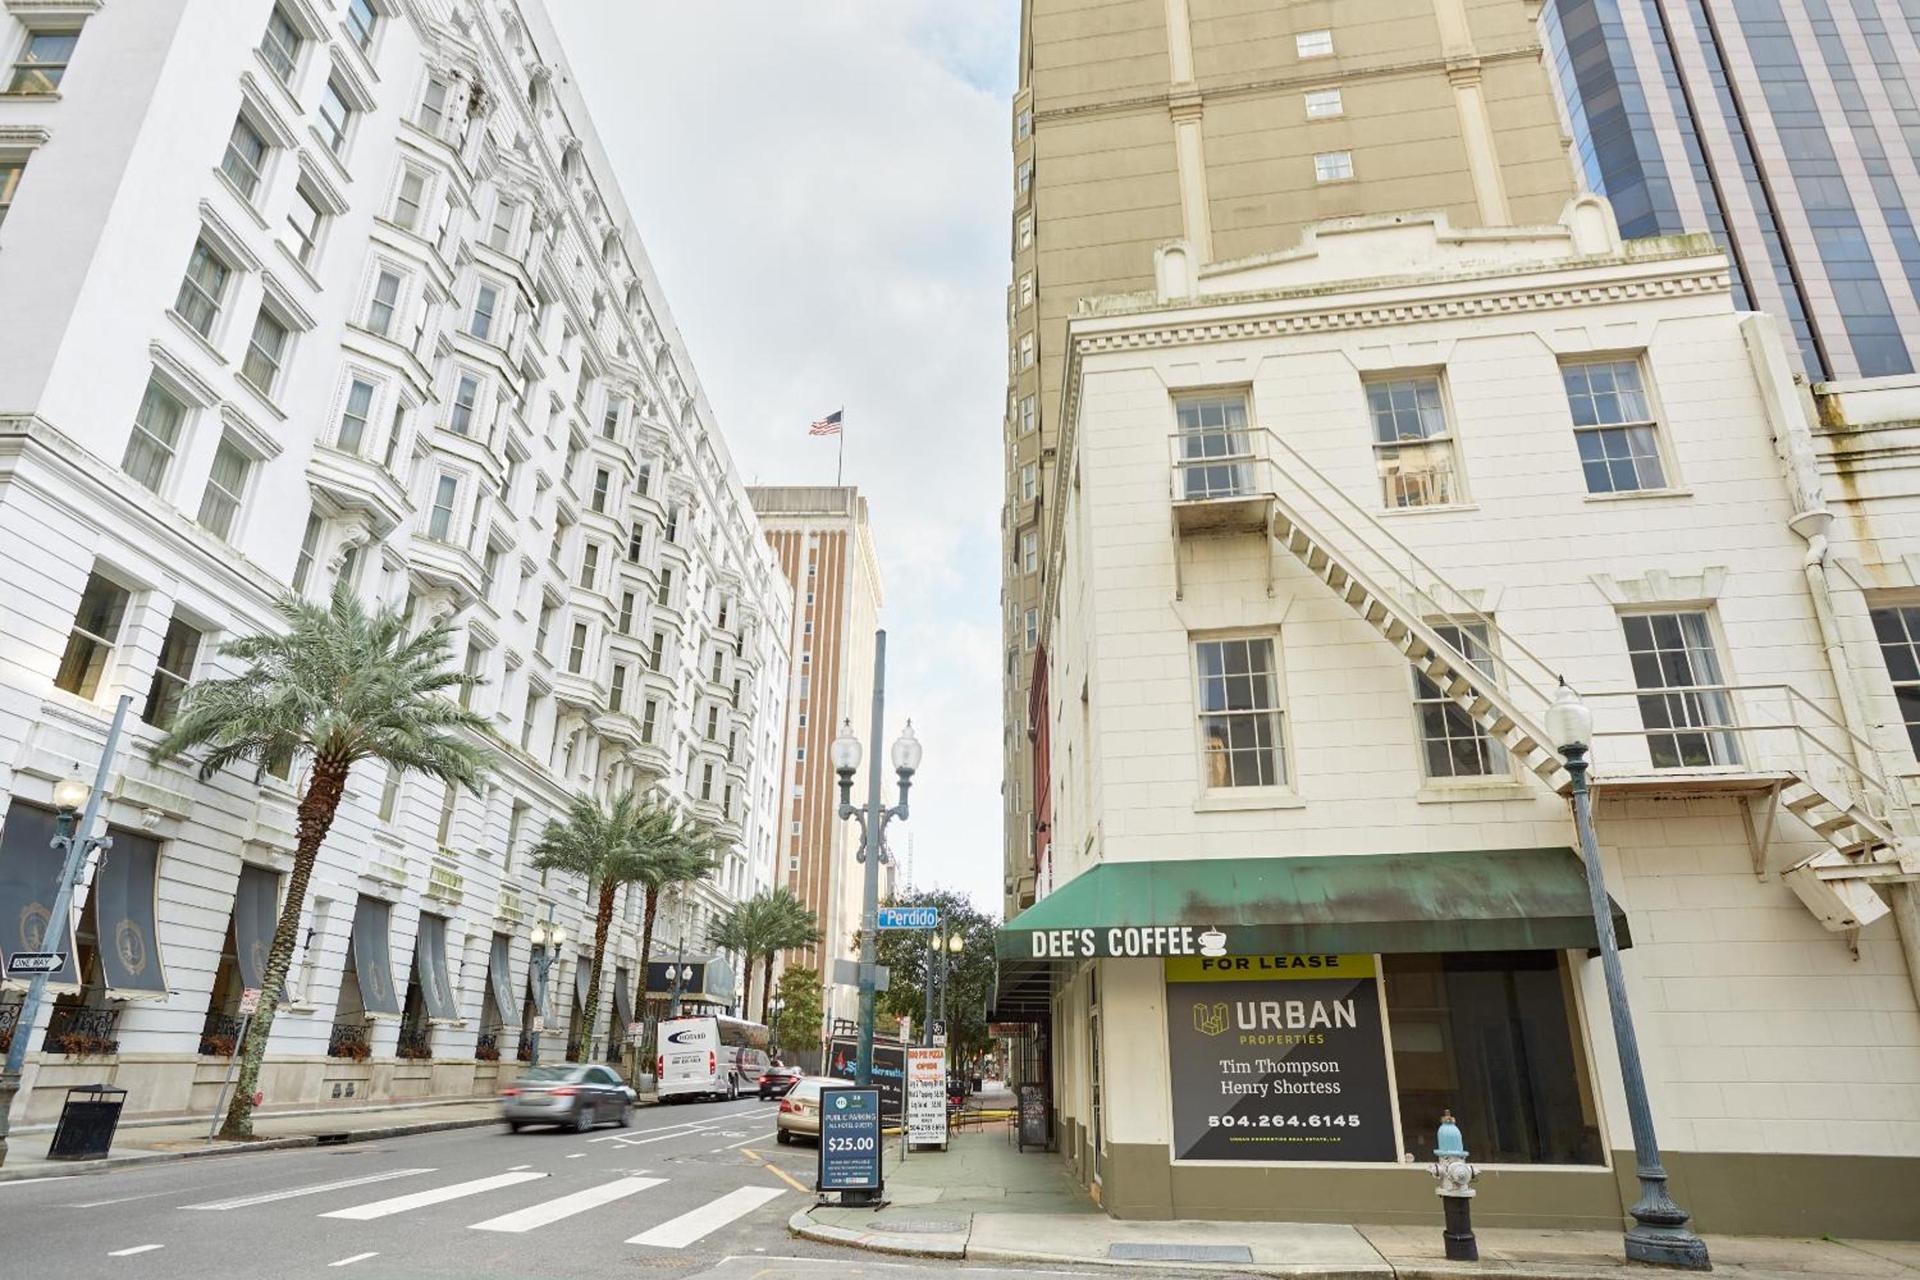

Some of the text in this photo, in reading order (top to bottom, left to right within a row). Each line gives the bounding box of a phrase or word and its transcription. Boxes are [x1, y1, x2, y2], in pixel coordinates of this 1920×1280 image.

[887, 910, 935, 926] Perdido
[1032, 926, 1195, 957] DEE'S COFFEE
[15, 959, 50, 967] ONE WAY
[1202, 955, 1339, 971] FOR LEASE
[1236, 1000, 1357, 1030] URBAN
[1240, 1034, 1325, 1046] PROPERTIES
[1219, 1059, 1340, 1076] Tim Thompson
[1220, 1079, 1341, 1098] Henry Shortess
[1208, 1115, 1361, 1128] 504.264.6145
[828, 1136, 874, 1152] $25.00
